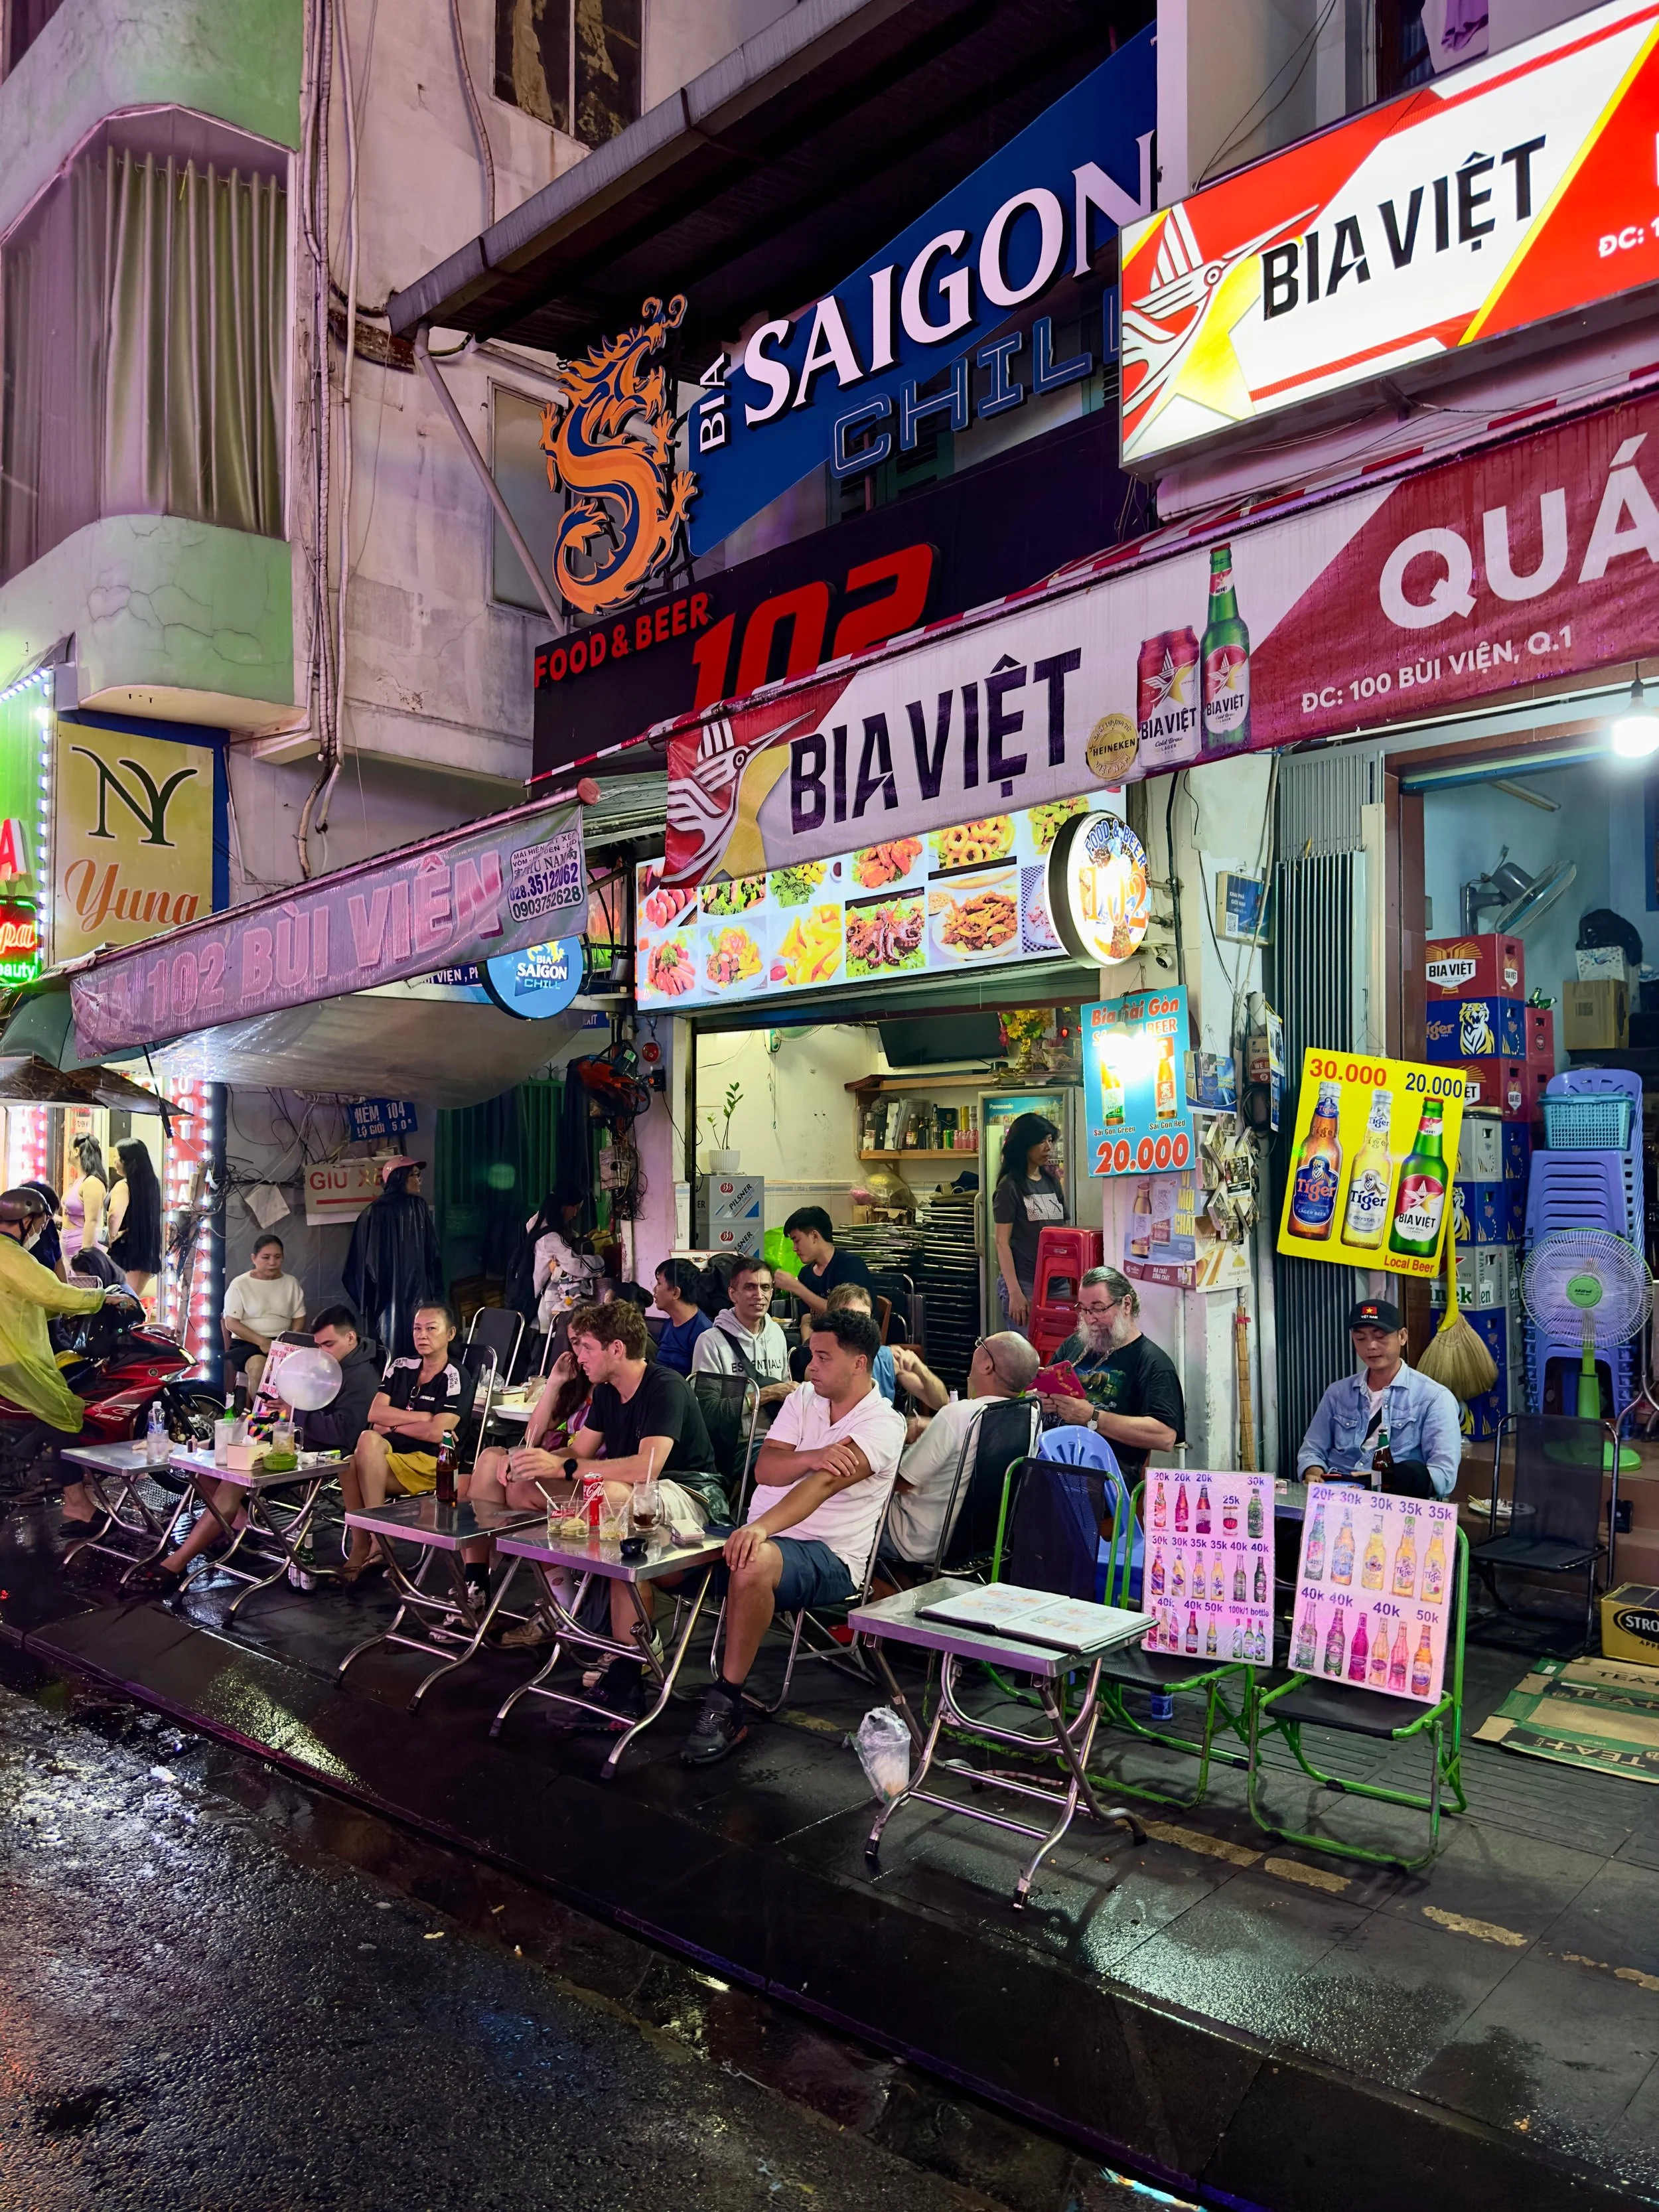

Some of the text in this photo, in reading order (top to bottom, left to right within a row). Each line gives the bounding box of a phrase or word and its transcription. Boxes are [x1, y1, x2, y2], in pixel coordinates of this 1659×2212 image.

[1261, 215, 1371, 322] BIA
[1377, 134, 1547, 269] VIỆT
[745, 129, 1155, 425] SAIGON
[700, 352, 731, 453] BIA
[1380, 431, 1659, 629] QUÁ
[692, 542, 932, 711] 102
[535, 592, 708, 688] FOOD & BEER
[1302, 625, 1572, 713] ĐC: 100 BÙI VIỆN, Q.1
[1206, 694, 1244, 716] BIA VIỆT
[1141, 707, 1196, 740] BIA VIỆT
[790, 646, 1082, 834] BIA VIỆT
[1093, 737, 1135, 757] HEINEKEN
[70, 745, 198, 848] NY
[1084, 819, 1147, 868] FOOD & BEER
[512, 885, 581, 919] 0903752628
[1079, 865, 1148, 929] 102
[147, 942, 226, 1023] 102
[242, 903, 330, 998] BÙI
[517, 962, 567, 980] SAIGON
[536, 954, 551, 964] BIA
[1429, 961, 1473, 978] BIA VIỆT
[524, 978, 561, 990] CHILL
[1091, 1006, 1117, 1027] Bia
[1148, 995, 1180, 1017] Gòn
[1146, 1017, 1179, 1035] BEER
[1427, 1020, 1455, 1041] iger
[1309, 1058, 1387, 1087] 30.000
[1405, 1072, 1463, 1098] 20.000
[386, 1101, 405, 1120] 104
[1369, 1116, 1390, 1129] Tiger
[1094, 1132, 1190, 1175] 20.000
[729, 1183, 753, 1211] PILSNER
[1297, 1178, 1336, 1203] Tiger
[1350, 1189, 1386, 1211] Tiger
[1398, 1213, 1436, 1229] BIA VIỆT
[1384, 1254, 1435, 1274] Local Beer
[1480, 1290, 1490, 1304] en
[1154, 1472, 1264, 1486] 20k 20k 20k 30k
[1223, 1496, 1240, 1505] 25k
[1313, 1487, 1452, 1520] 20k 30k 30k 35k 35k
[1152, 1535, 1269, 1552] 30k 30k 35k 35k 40k 40k
[1396, 1566, 1414, 1578] Tiger
[1184, 1600, 1202, 1611] 40k
[1204, 1602, 1223, 1613] 50k
[1228, 1606, 1248, 1615] 100k/1
[1250, 1607, 1269, 1617] bottle
[1301, 1587, 1439, 1623] 40k 40k 40k 50k
